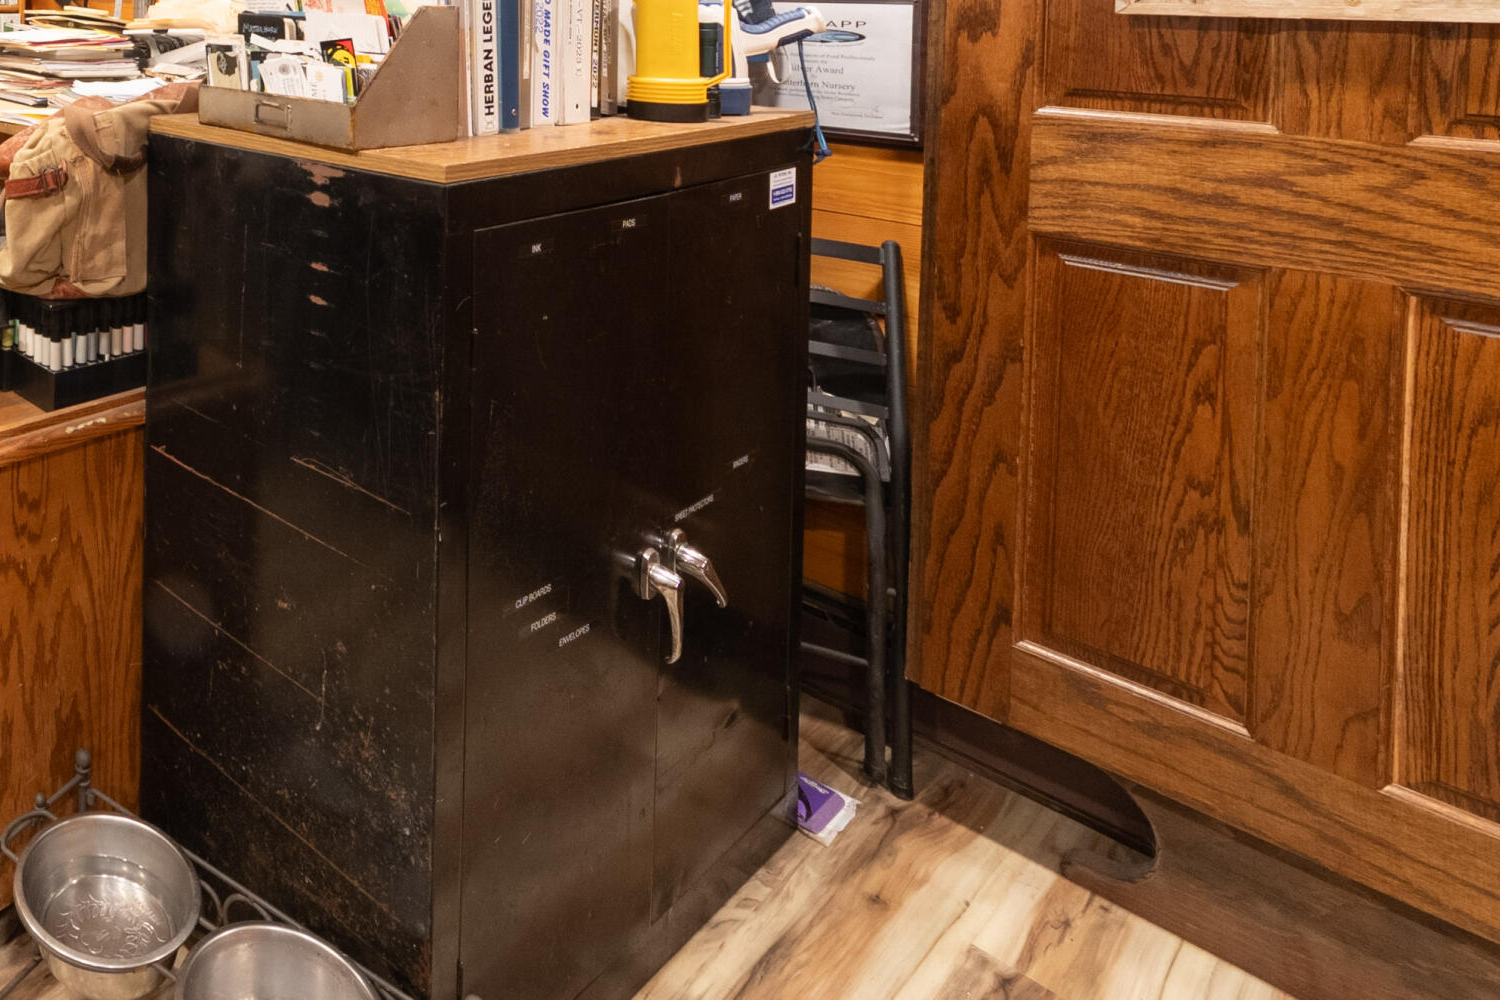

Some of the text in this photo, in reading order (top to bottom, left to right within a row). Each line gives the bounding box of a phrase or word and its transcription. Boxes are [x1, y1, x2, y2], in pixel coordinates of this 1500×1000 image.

[534, 1, 544, 34] 2022
[542, 7, 552, 46] MADE
[826, 20, 868, 29] APP
[542, 49, 551, 78] GIFT
[815, 64, 845, 76] Award
[483, 49, 495, 117] HERBAN
[821, 80, 856, 91] Nursery
[540, 81, 550, 118] SHOW
[622, 218, 636, 229] PADS
[531, 243, 542, 254] INK
[515, 583, 552, 609] CLIP BOARDS
[530, 612, 557, 632] FOLDERS
[559, 623, 590, 647] ENVELOPES
